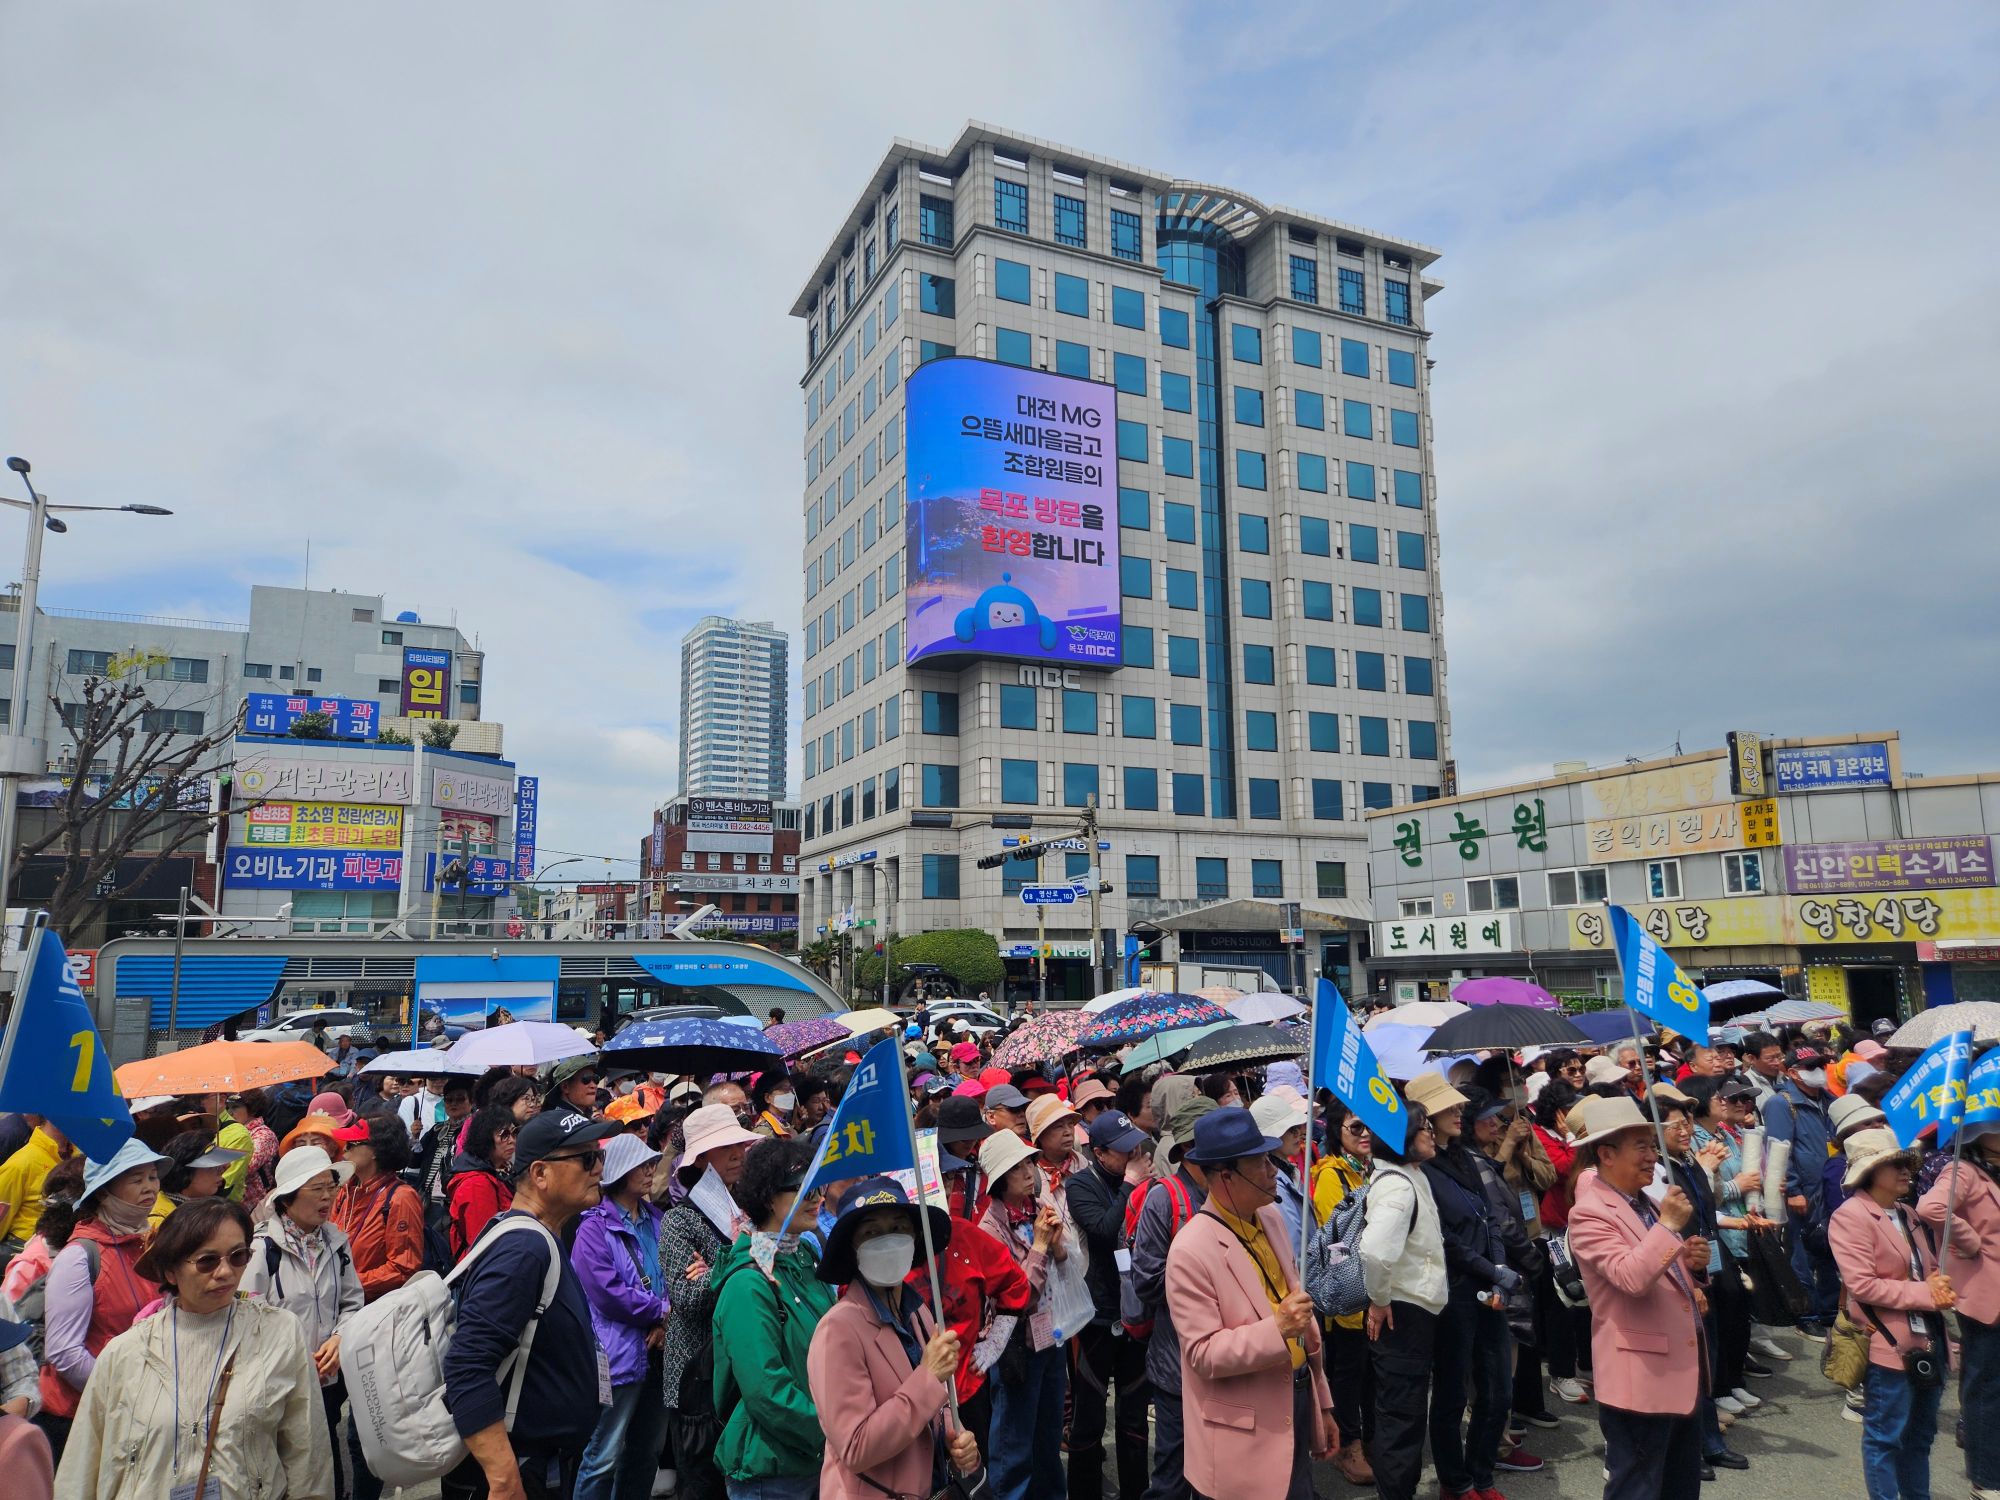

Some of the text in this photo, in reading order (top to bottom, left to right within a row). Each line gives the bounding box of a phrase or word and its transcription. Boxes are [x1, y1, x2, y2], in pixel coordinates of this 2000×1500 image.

[1017, 394, 1101, 428] 대전 MG
[961, 415, 1102, 458] 으뜸새마을금고
[1004, 451, 1102, 487] 조합원들의
[979, 487, 1104, 531] 목포 방문을
[981, 525, 1105, 567] 환영합니다
[1085, 644, 1115, 657] MBC
[1019, 665, 1080, 690] MBC
[256, 714, 372, 736] 비과
[1807, 759, 1831, 778] 국제
[1834, 756, 1886, 777] 결혼정보
[272, 767, 411, 801] 피부관리실
[252, 805, 399, 827] 전남최초 초소형 전립선검사
[520, 779, 536, 832] 오비뇨기과
[705, 801, 771, 815] 맨스톤 비뇨기과
[1393, 798, 1548, 867] 권농원
[232, 855, 338, 882] 오비뇨기과
[342, 856, 403, 884] 피부과
[1793, 849, 1988, 880] 신안인력소개소
[745, 877, 800, 890] 치과의
[1024, 893, 1033, 901] 98
[1039, 890, 1059, 898] 영산로
[1576, 905, 1711, 946] 영식당
[1799, 896, 1942, 939] 영창식당
[1211, 935, 1273, 947] OPEN STUDIO
[1390, 919, 1502, 950] 도시원예
[361, 1374, 387, 1447] GEOGRAPHIC
[367, 1369, 387, 1427] NATIONAL
